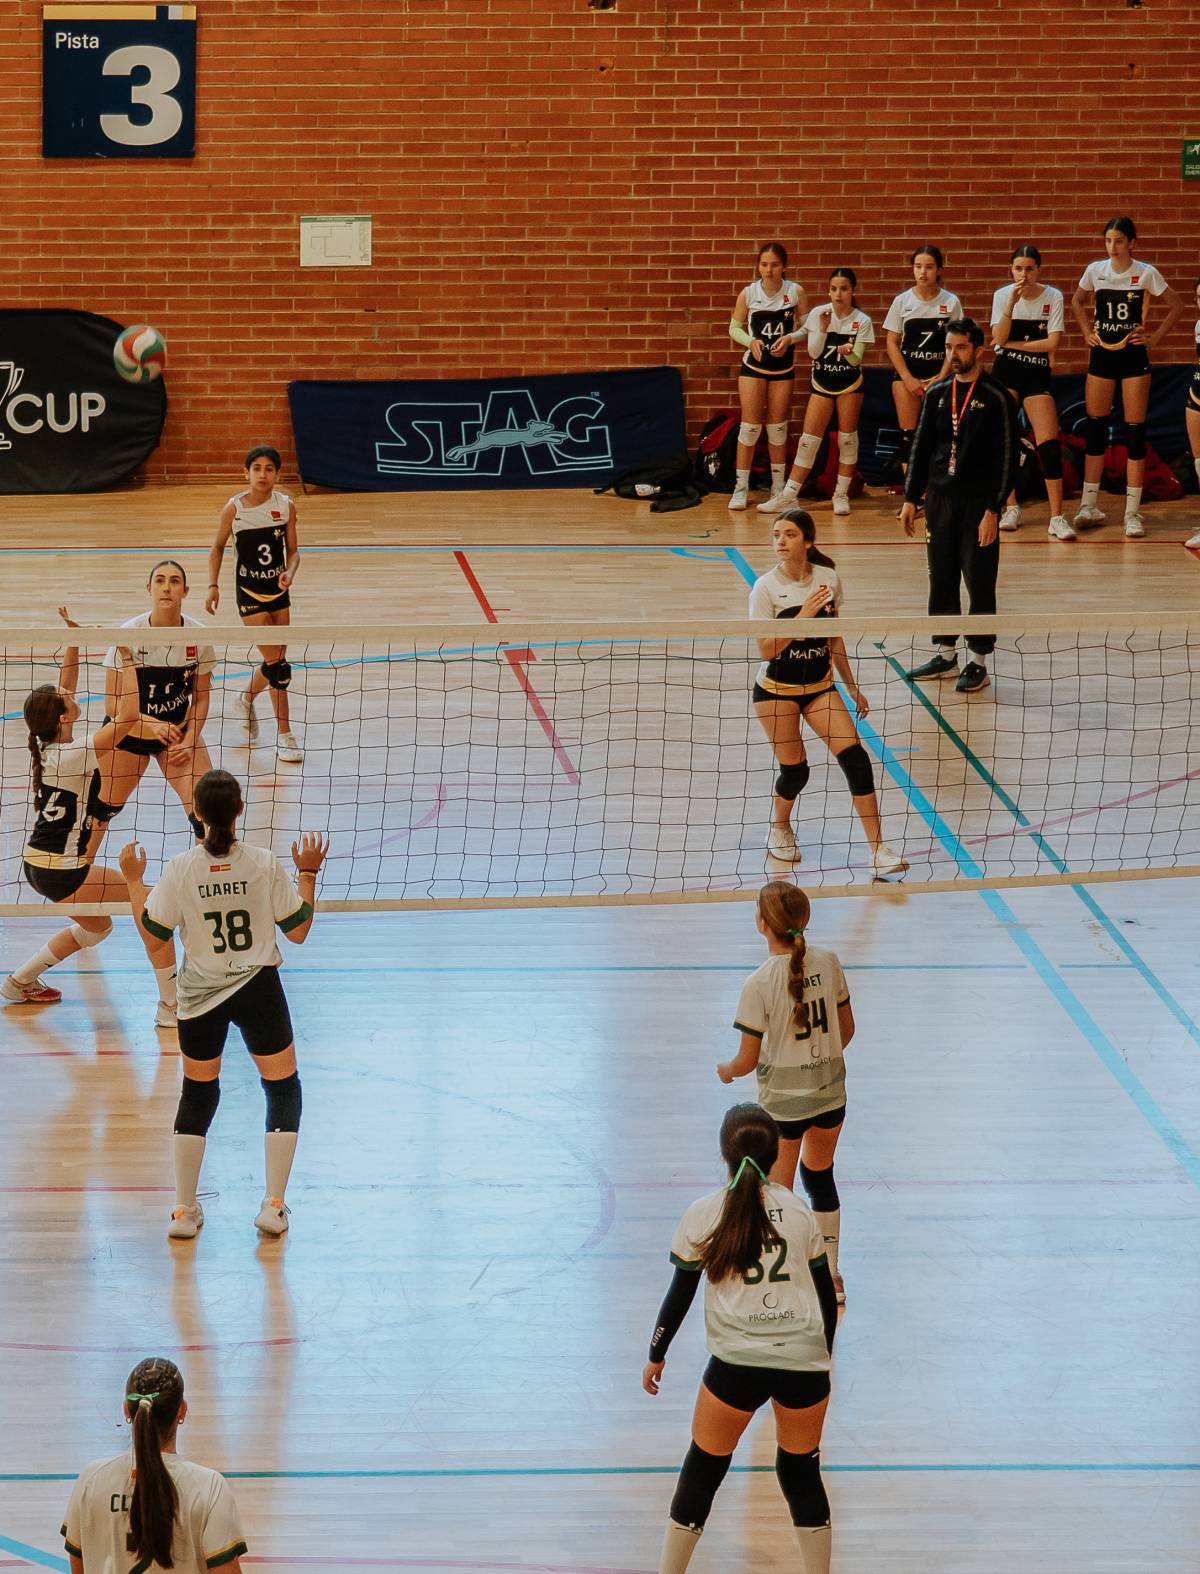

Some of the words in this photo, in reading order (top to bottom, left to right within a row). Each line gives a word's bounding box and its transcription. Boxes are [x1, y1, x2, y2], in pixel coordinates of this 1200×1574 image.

[54, 31, 100, 50] Pista
[99, 45, 183, 147] 3
[1106, 302, 1129, 320] 18
[761, 322, 785, 339] 44
[917, 331, 933, 348] 7
[1007, 351, 1048, 367] MADRID
[6, 392, 107, 433] CUP
[375, 390, 614, 476] STAG
[257, 543, 273, 566] 3
[197, 880, 248, 899] CLARET
[203, 909, 253, 954] 38
[748, 1310, 795, 1323] PROCLADE
